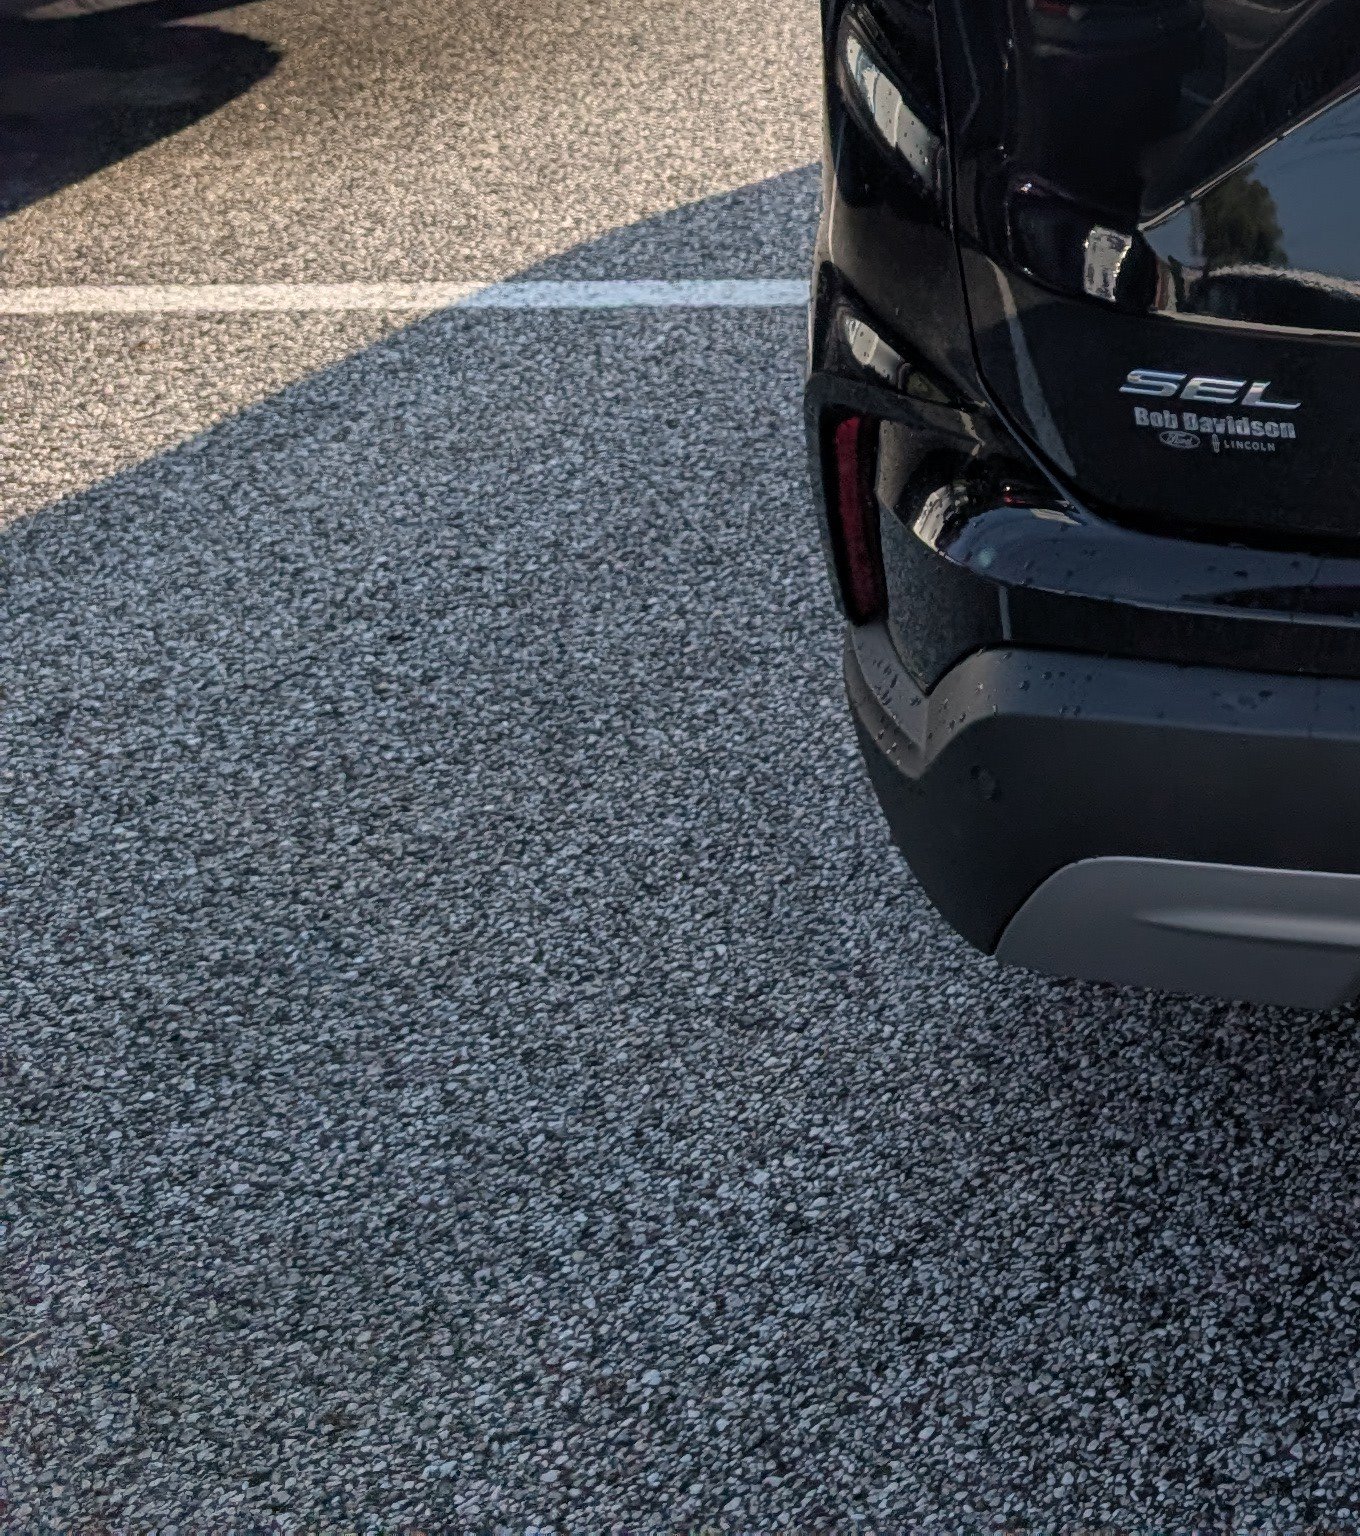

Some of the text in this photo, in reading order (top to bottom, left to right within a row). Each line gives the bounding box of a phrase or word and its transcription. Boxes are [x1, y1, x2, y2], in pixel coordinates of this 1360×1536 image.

[1119, 368, 1302, 410] SEL
[1134, 406, 1297, 439] Bob Davidson
[1224, 439, 1276, 452] LINCOLN
